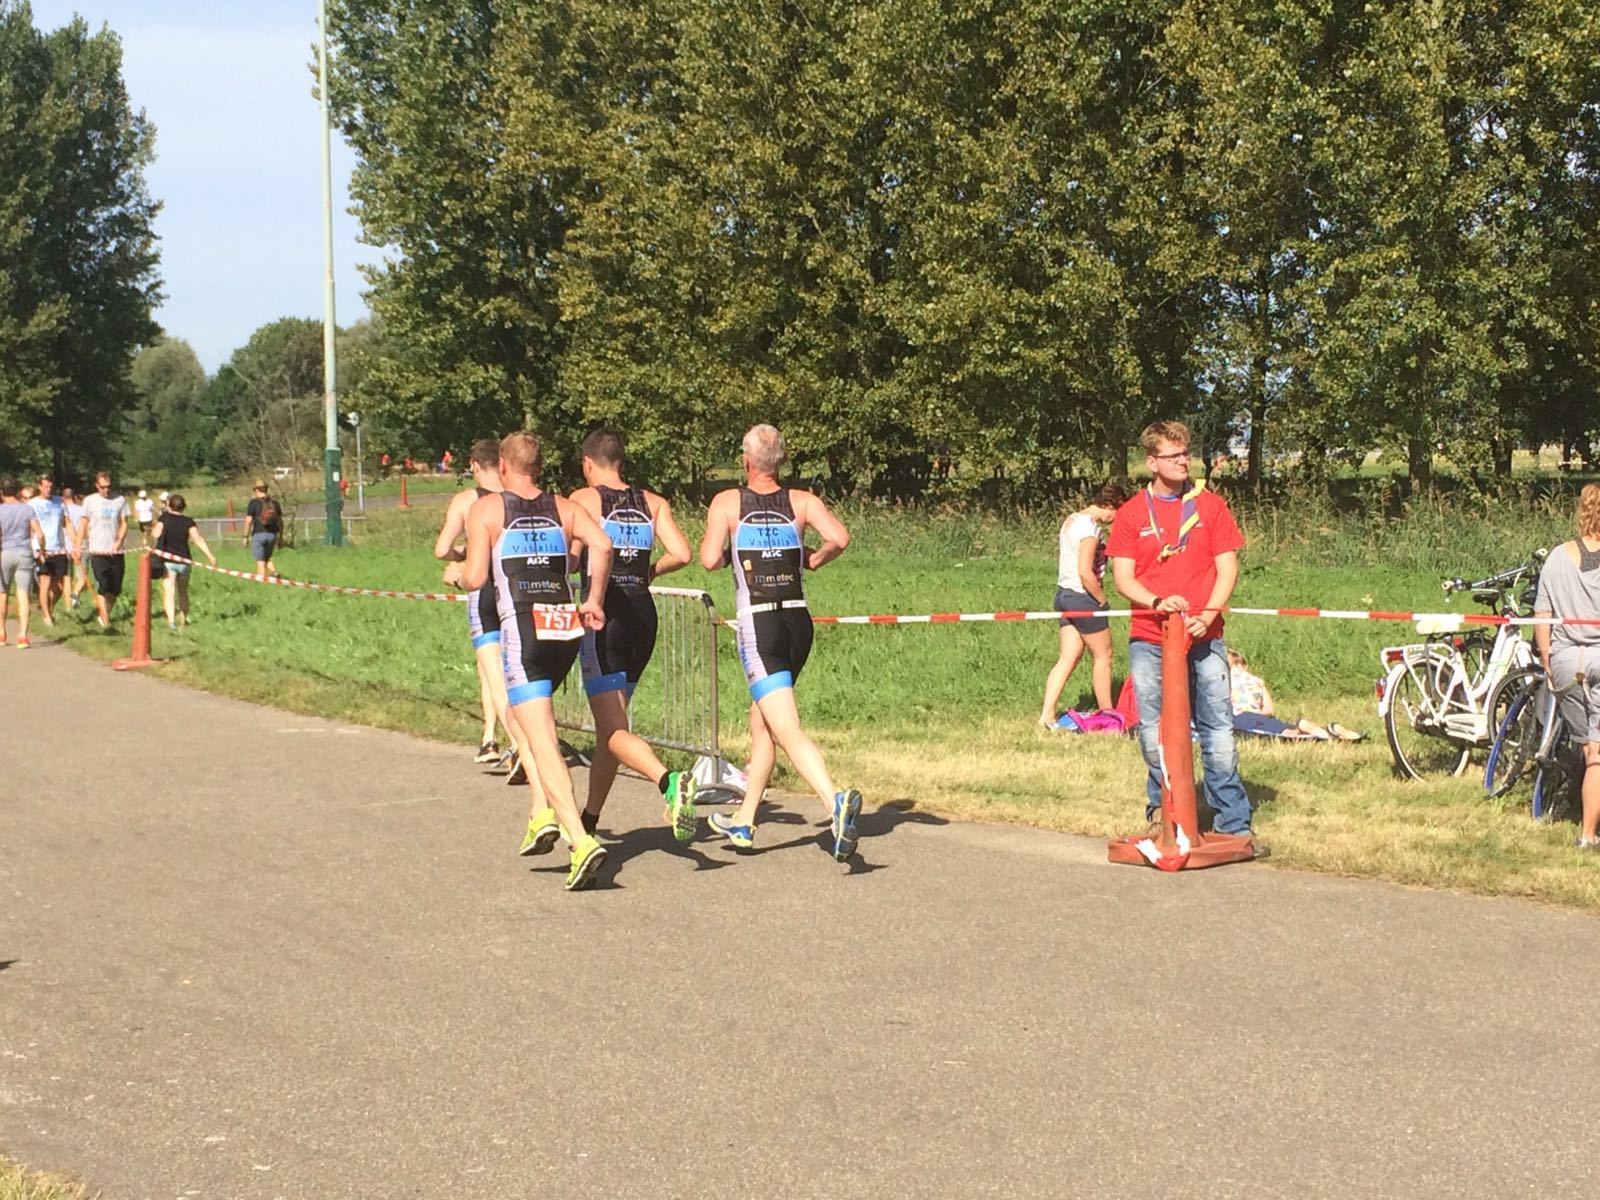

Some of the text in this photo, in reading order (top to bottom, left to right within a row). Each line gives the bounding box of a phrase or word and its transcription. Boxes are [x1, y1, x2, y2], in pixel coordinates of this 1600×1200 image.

[619, 525, 639, 535] TZC
[757, 528, 779, 537] TZC
[522, 532, 547, 542] TZC
[540, 611, 573, 630] 757
